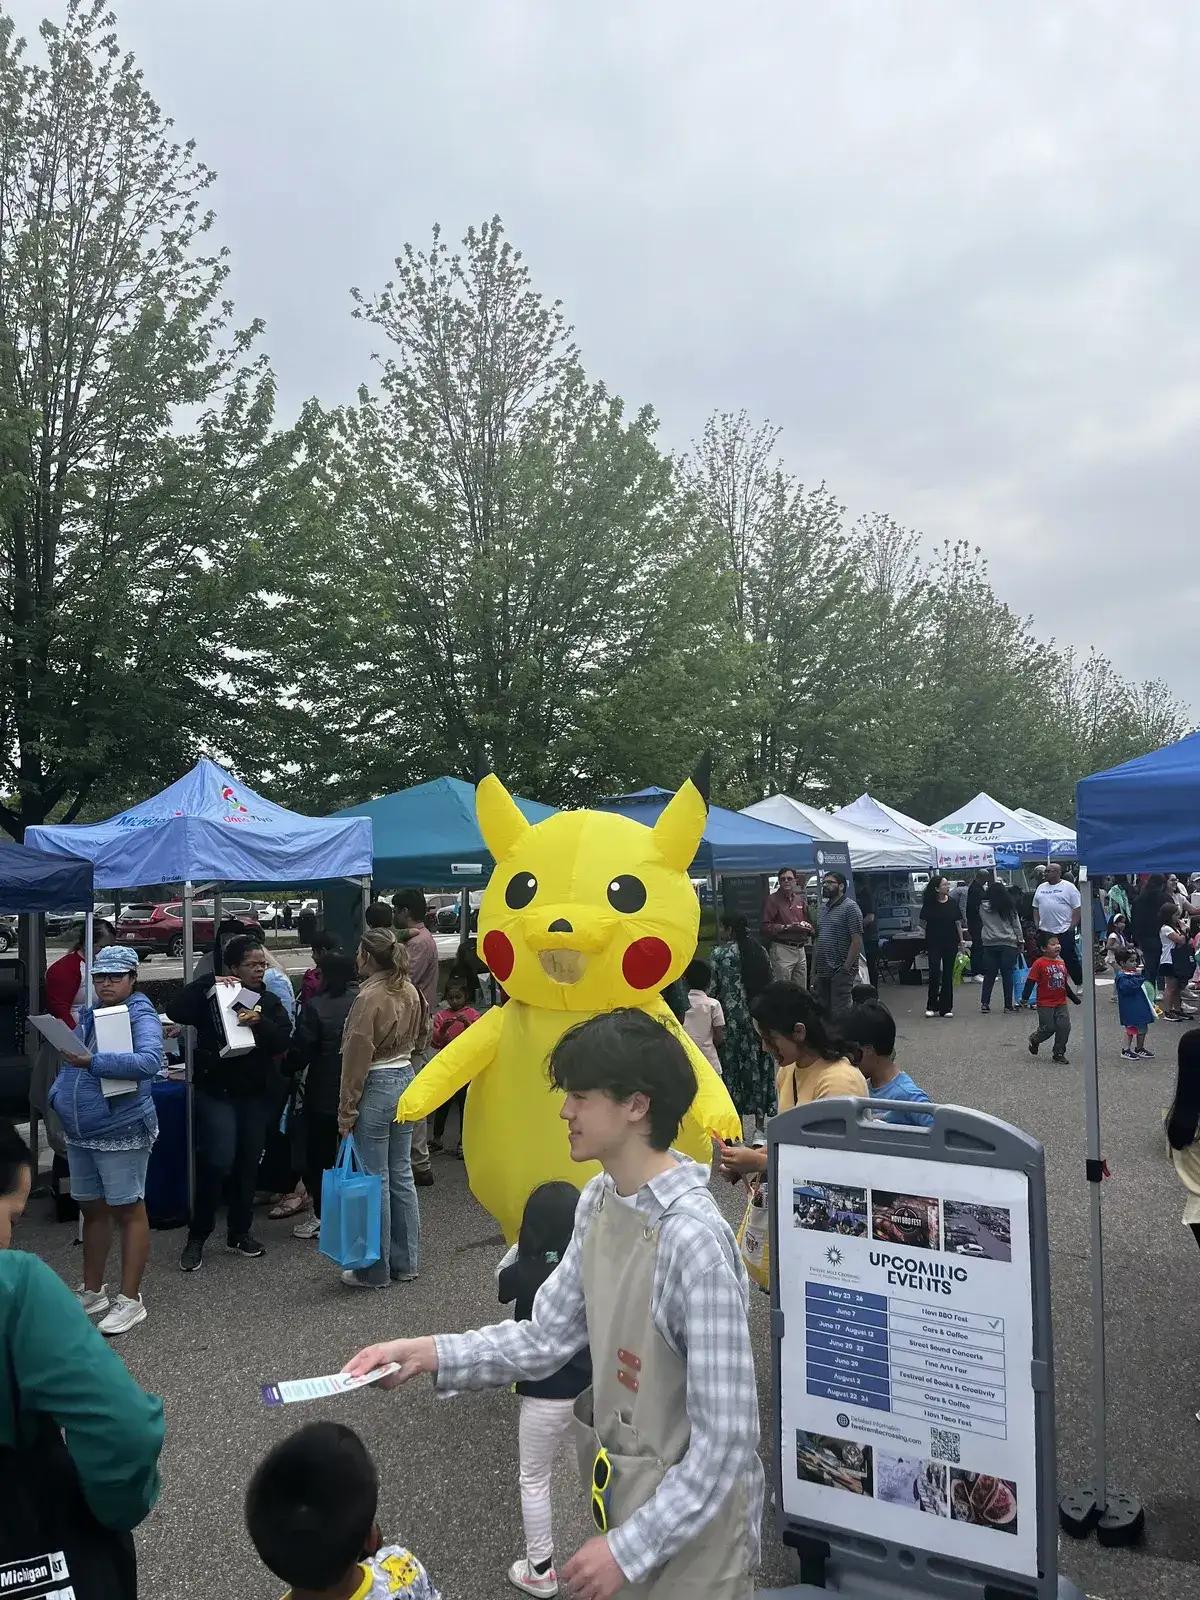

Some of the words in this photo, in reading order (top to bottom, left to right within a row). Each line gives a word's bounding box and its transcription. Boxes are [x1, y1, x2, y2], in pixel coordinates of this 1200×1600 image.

[962, 821, 1006, 835] IEP
[995, 842, 1034, 854] CARE
[869, 1252, 968, 1282] UPCOMING
[888, 1270, 952, 1295] EVENTS
[828, 1290, 842, 1299] May
[836, 1308, 851, 1316] June
[921, 1308, 937, 1317] Novi
[938, 1311, 953, 1320] BBQ
[954, 1313, 968, 1323] Fest
[818, 1321, 834, 1329] June
[845, 1326, 867, 1336] August
[922, 1325, 939, 1334] Cars
[946, 1330, 969, 1340] Coffee
[828, 1339, 844, 1348] June
[845, 1342, 853, 1350] 20
[909, 1339, 929, 1349] Street
[929, 1343, 951, 1354] Sound
[951, 1348, 983, 1361] Concerts
[834, 1357, 850, 1366] June
[924, 1359, 939, 1368] Fine
[939, 1363, 953, 1372] Arts
[954, 1365, 968, 1375] Fair
[833, 1373, 856, 1383] August
[899, 1370, 925, 1382] Festival
[933, 1378, 954, 1389] Books
[961, 1385, 996, 1399] Creativity
[827, 1388, 849, 1398] August
[849, 1392, 858, 1400] 22
[924, 1393, 941, 1403] Cars
[947, 1399, 971, 1410] Coffee
[850, 1415, 872, 1425] Detailed
[872, 1419, 902, 1432] Information
[924, 1409, 940, 1419] Novi
[940, 1414, 957, 1424] Taco
[957, 1417, 972, 1427] Fest
[0, 1565, 48, 1587] Michigan
